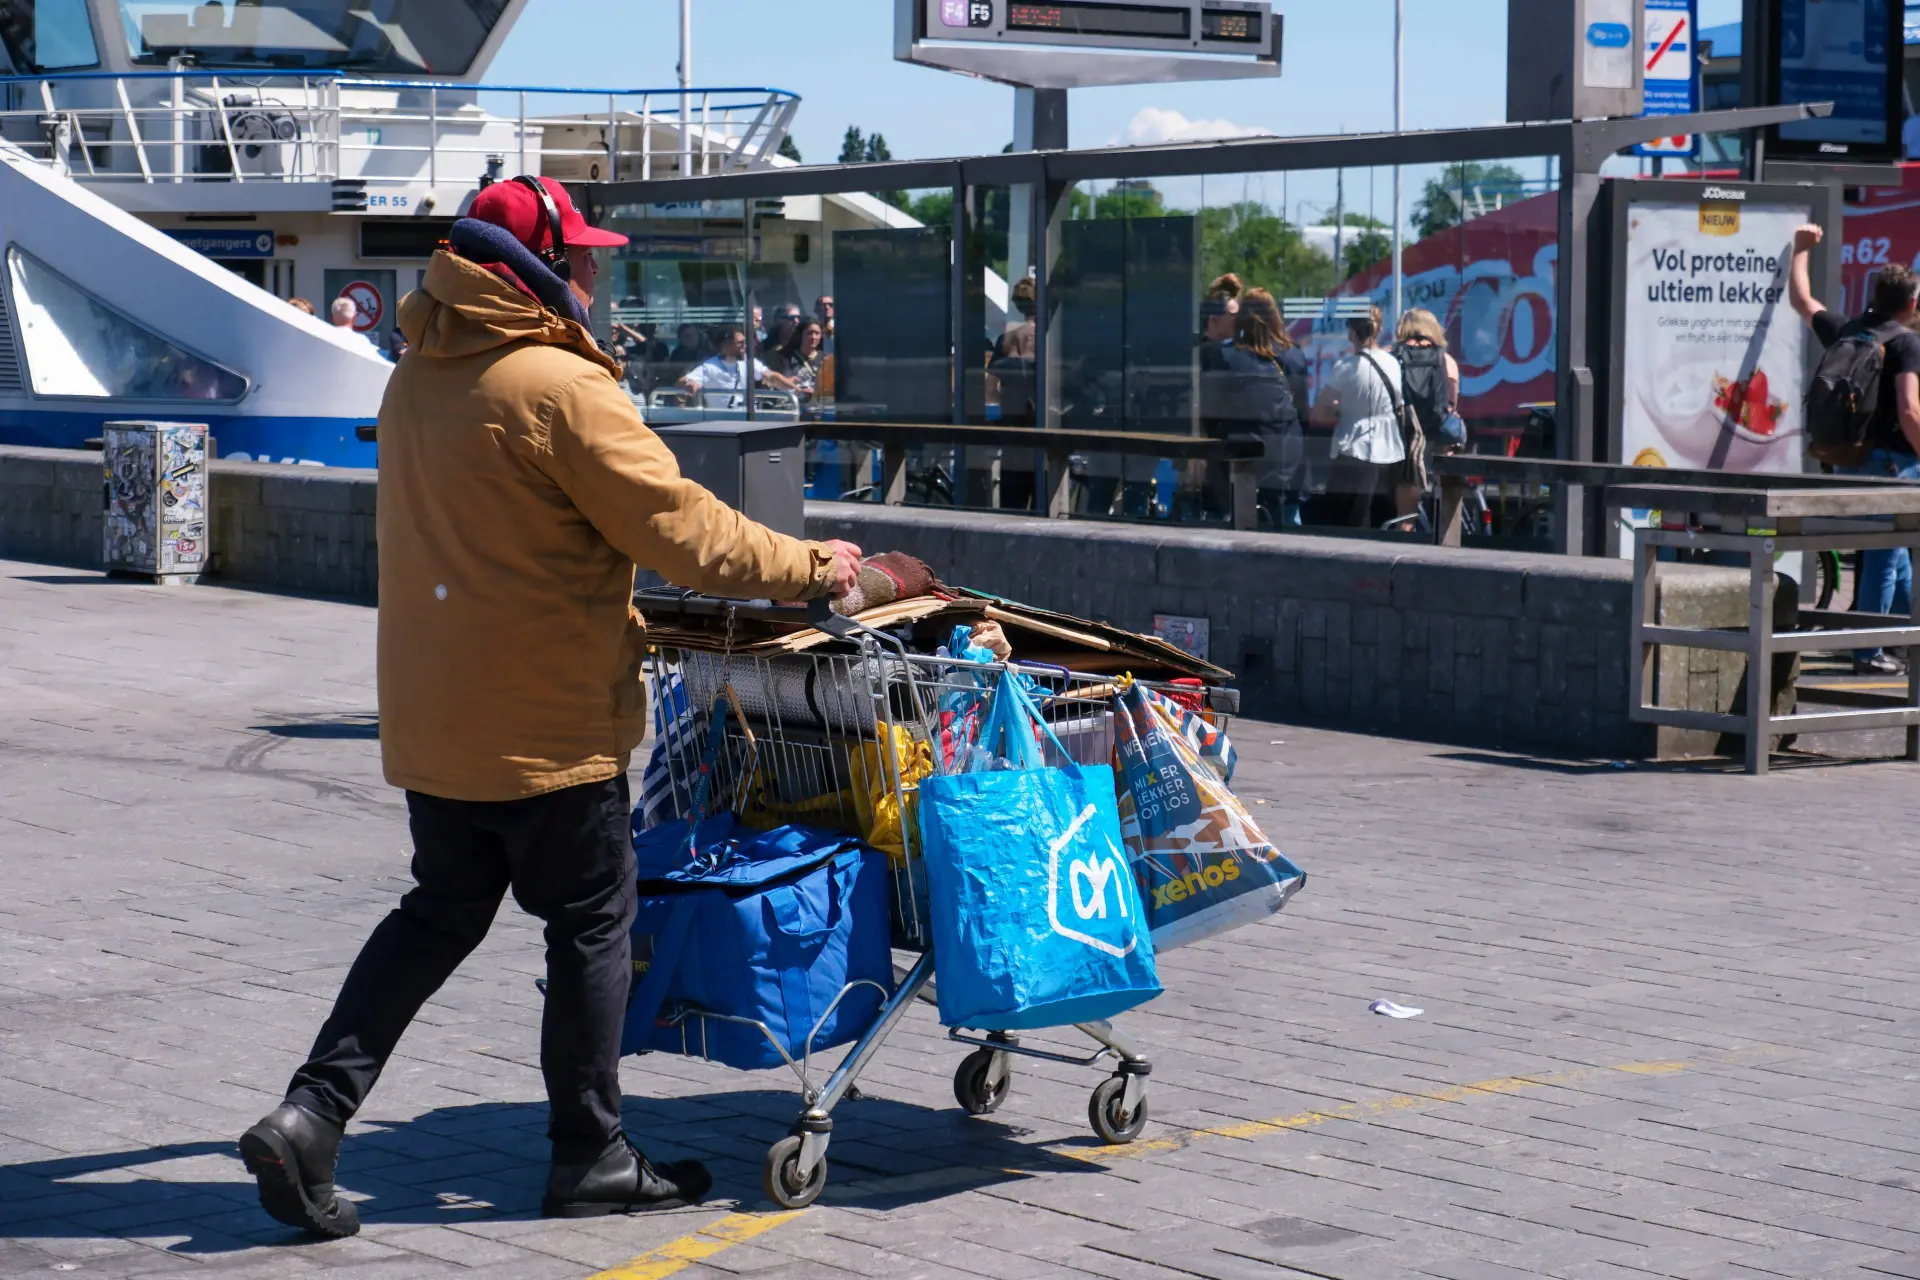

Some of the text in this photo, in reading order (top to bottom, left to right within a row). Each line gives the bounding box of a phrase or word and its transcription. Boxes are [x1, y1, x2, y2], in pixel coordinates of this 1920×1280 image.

[943, 2, 964, 20] F4
[970, 3, 990, 21] F5
[392, 196, 407, 206] 55
[1702, 186, 1746, 200] JCDecaux
[1702, 213, 1736, 227] NIEUW
[181, 238, 251, 251] oetgangers
[1857, 237, 1891, 264] 62
[1652, 248, 1782, 278] Vol proteïne,
[1647, 279, 1784, 304] ultiem lekker
[1657, 316, 1689, 328] Griekse
[1691, 318, 1724, 330] yoghurt
[1727, 319, 1742, 328] met
[1134, 764, 1180, 793] MIX ER
[1138, 778, 1186, 806] LEKKER
[1141, 793, 1190, 820] OP LOS
[1150, 858, 1241, 910] xenos
